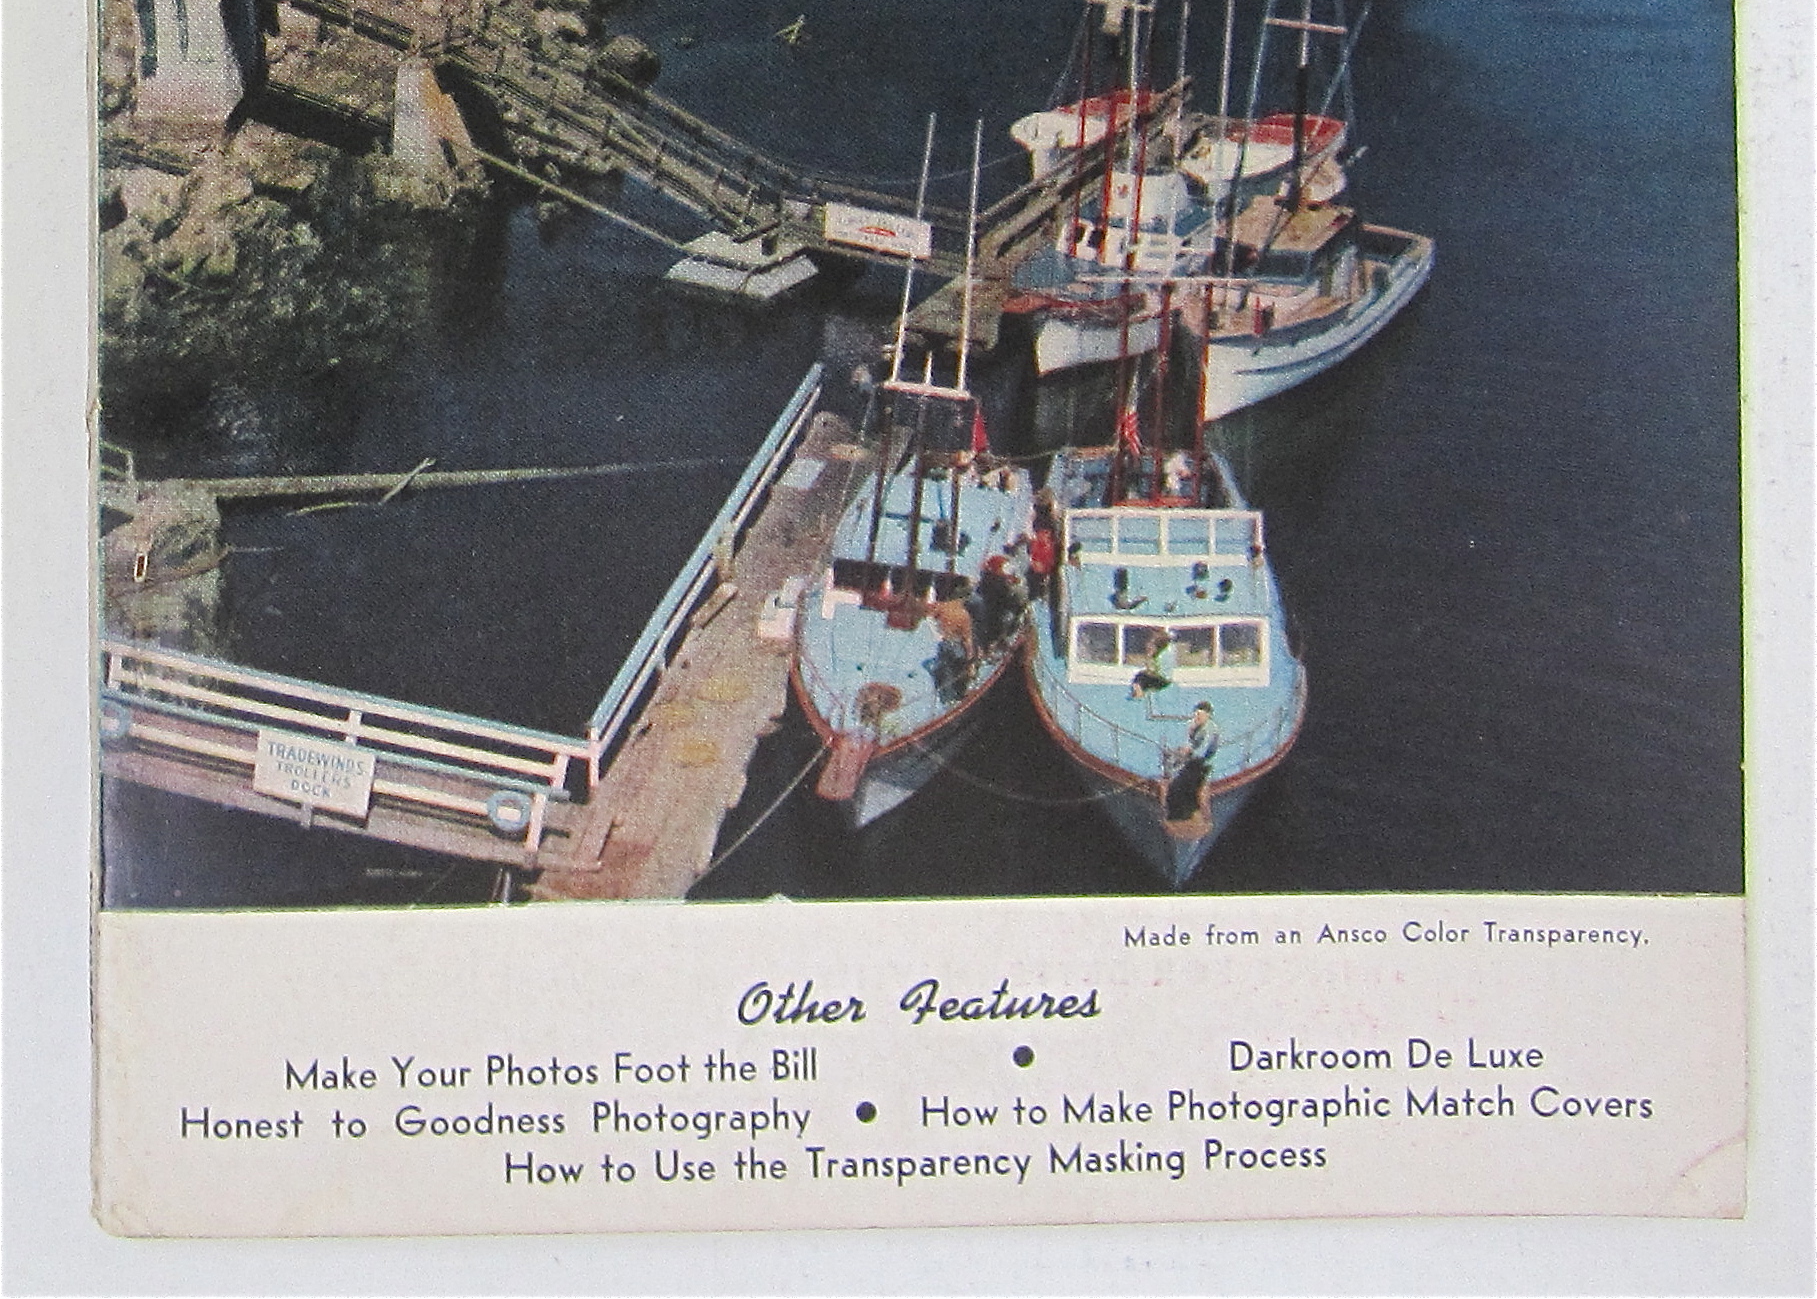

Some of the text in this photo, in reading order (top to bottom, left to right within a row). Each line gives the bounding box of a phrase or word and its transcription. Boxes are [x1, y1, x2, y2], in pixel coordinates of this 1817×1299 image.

[1125, 920, 1648, 948] Made from an Ansco Color Transparency.
[738, 979, 1100, 1025] Other Features
[287, 1048, 816, 1089] Make Your Photos Foot the Bill
[1231, 1038, 1543, 1071] Darkroom De Luxe
[182, 1098, 810, 1139] Honest to Goodness Photography
[922, 1085, 1652, 1127] How to Make Photographic Match Covers
[506, 1139, 1326, 1186] How to Use the Transparency Masking Process
